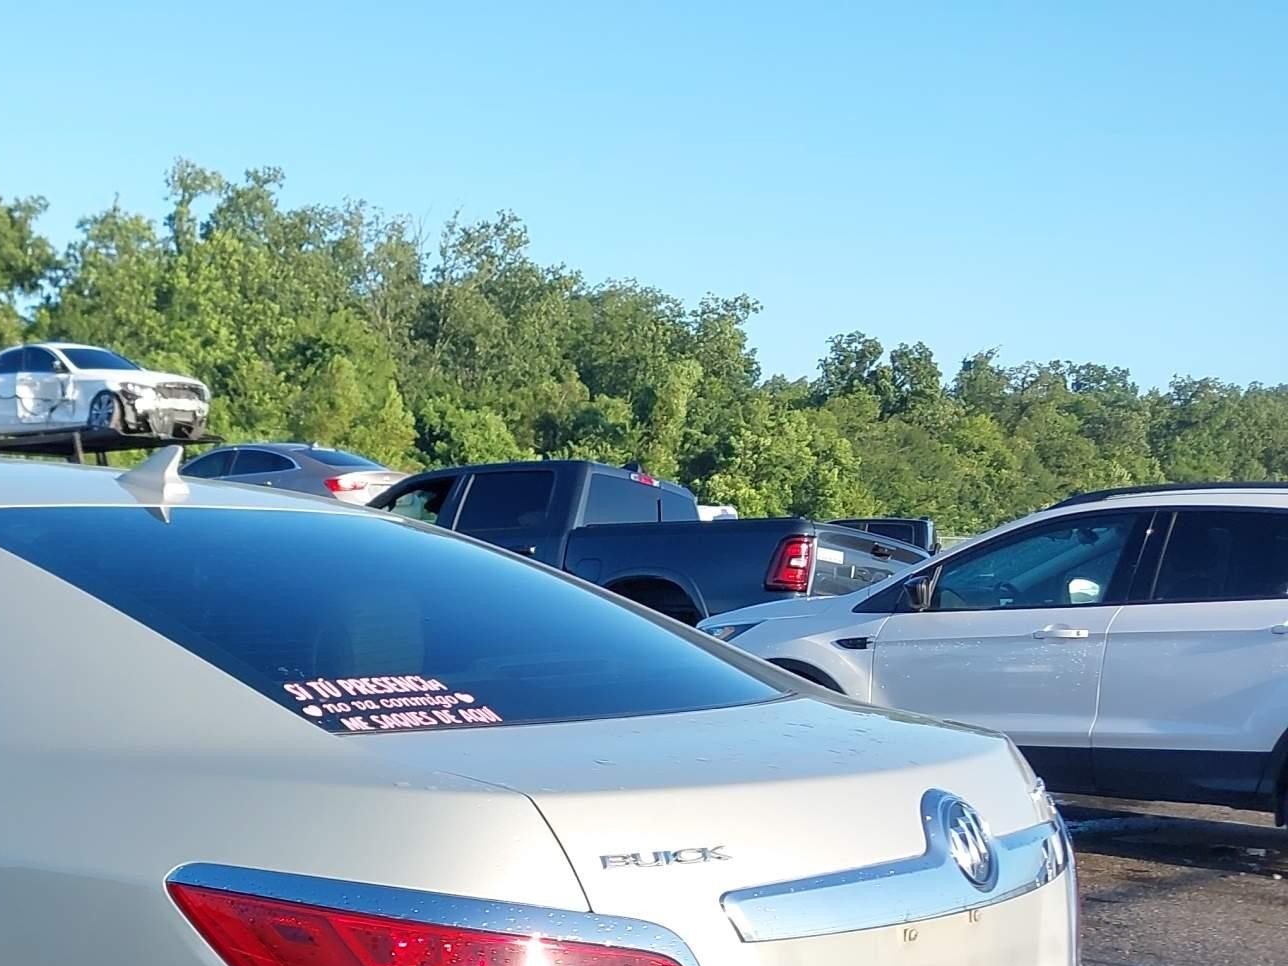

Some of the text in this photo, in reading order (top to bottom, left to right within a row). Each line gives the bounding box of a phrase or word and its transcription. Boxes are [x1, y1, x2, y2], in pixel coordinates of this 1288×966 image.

[335, 675, 448, 696] PRESENCIA
[322, 693, 459, 714] no va conmigo
[339, 715, 376, 731] ME
[369, 710, 438, 730] SAQUES
[431, 709, 463, 725] DE
[599, 845, 733, 870] BUICK
